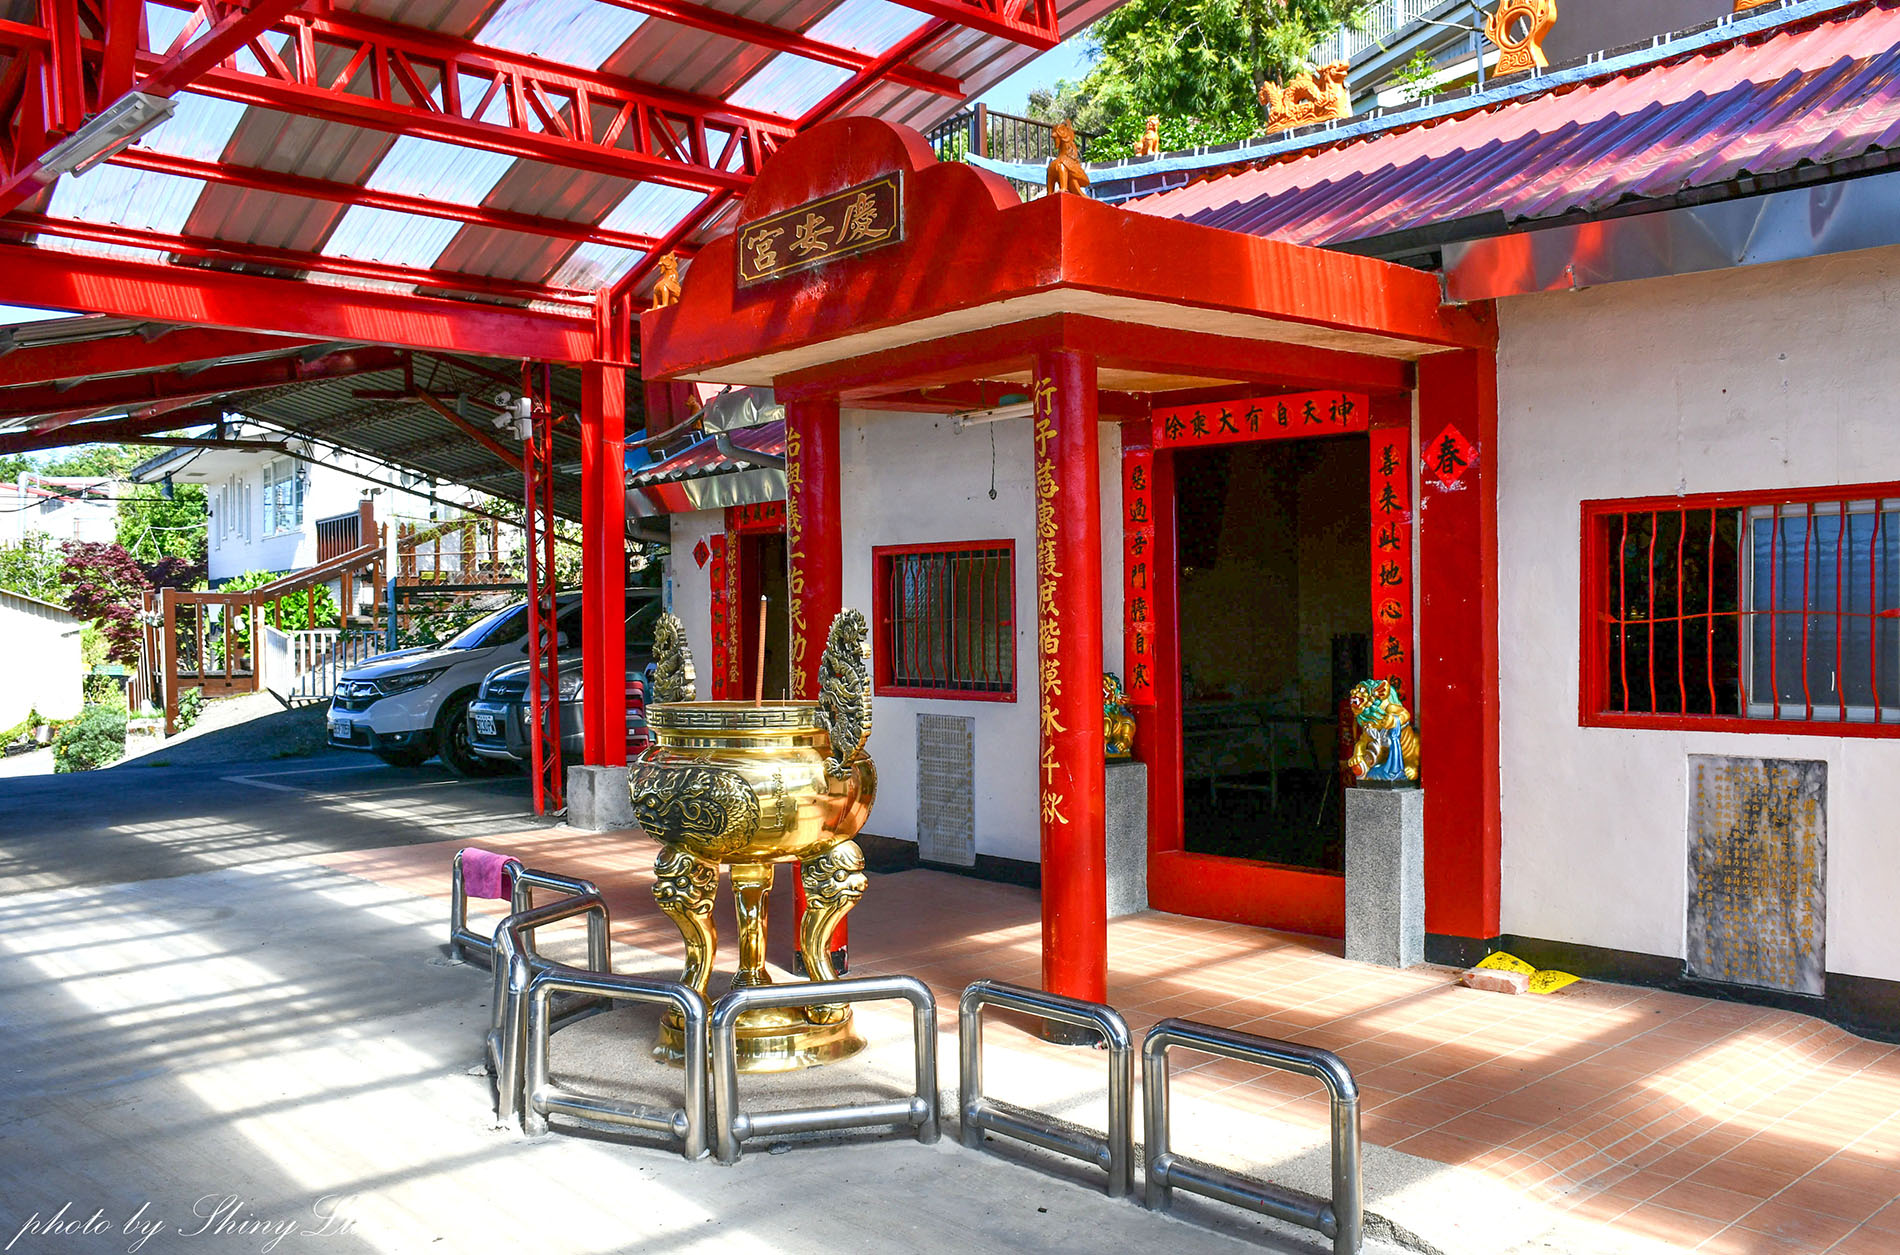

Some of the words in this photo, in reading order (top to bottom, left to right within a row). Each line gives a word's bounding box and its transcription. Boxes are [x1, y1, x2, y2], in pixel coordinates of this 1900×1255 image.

[747, 192, 888, 272] 慶安宮
[1164, 394, 1355, 440] 神天自有大乘除
[1433, 435, 1467, 475] 春
